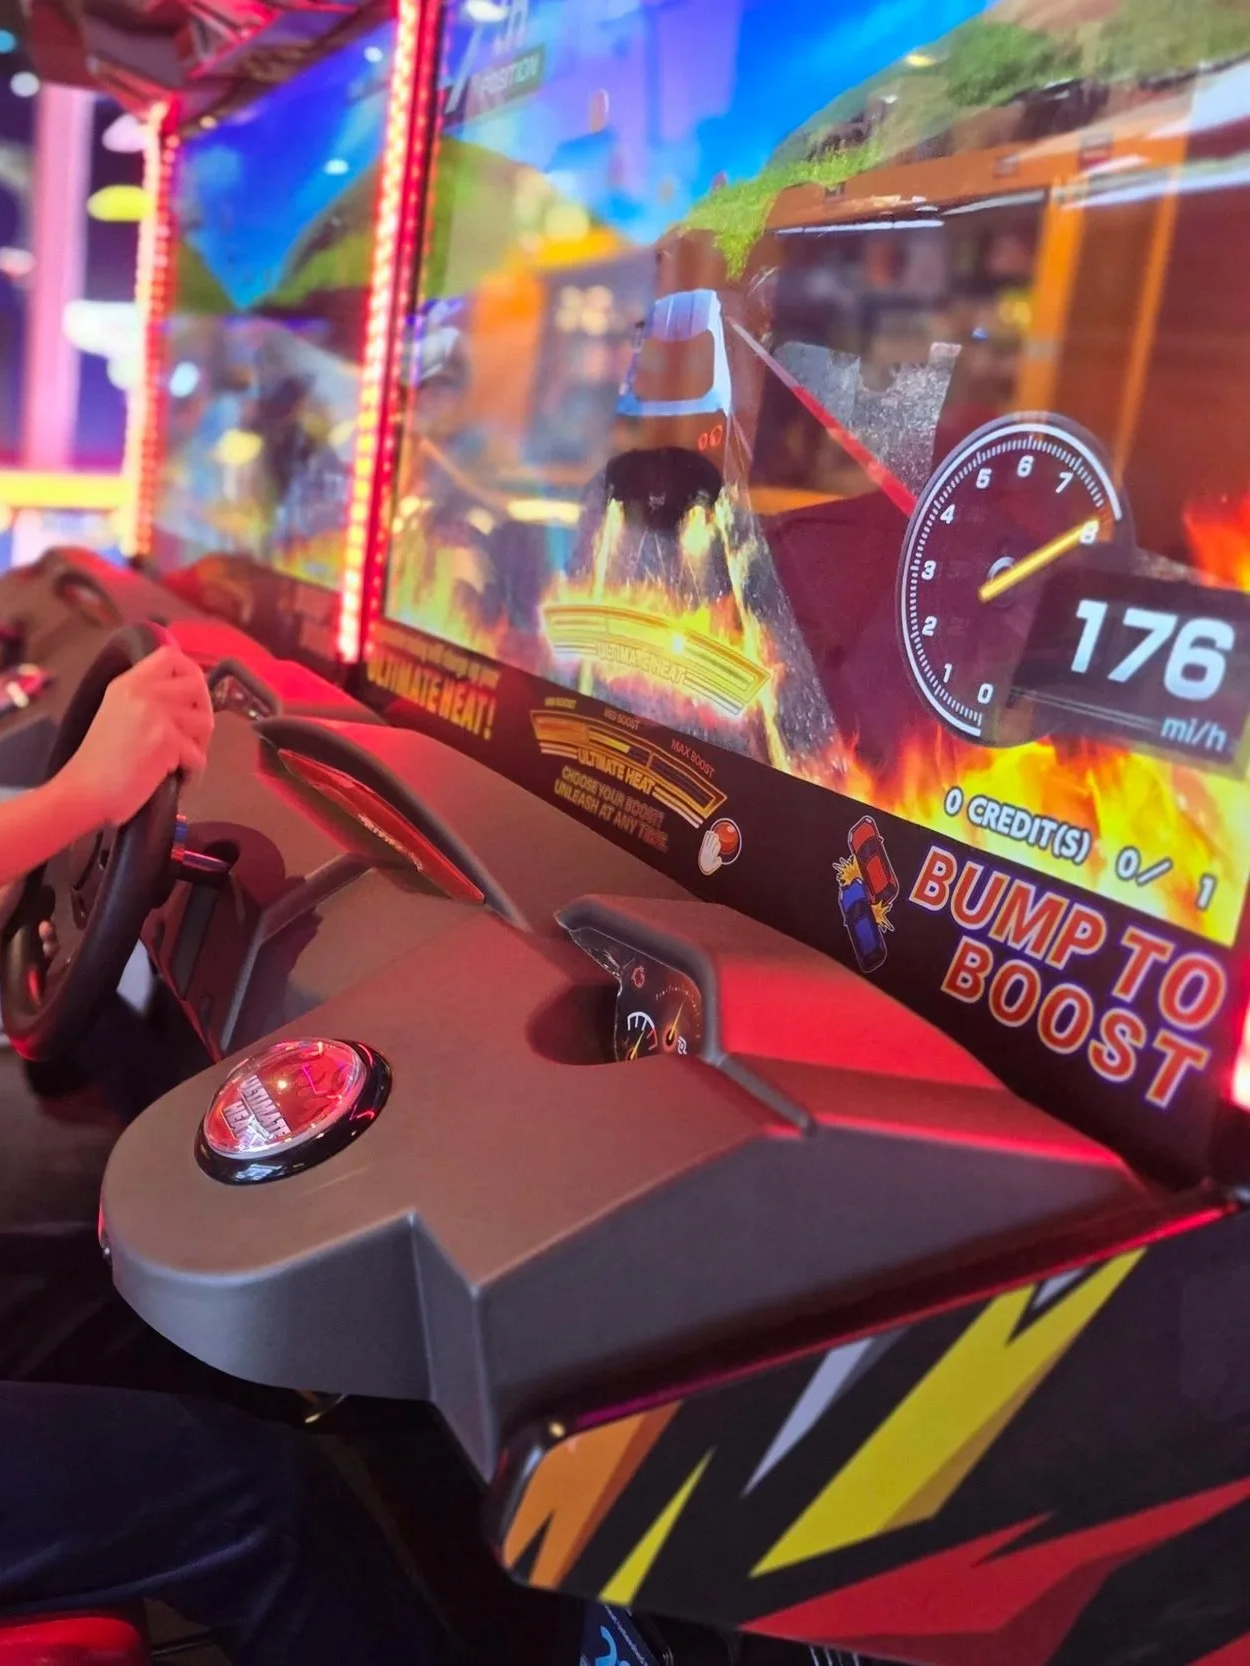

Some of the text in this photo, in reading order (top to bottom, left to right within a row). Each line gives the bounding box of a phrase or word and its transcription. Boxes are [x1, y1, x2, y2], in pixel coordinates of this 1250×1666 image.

[976, 467, 992, 489] 5
[1017, 455, 1034, 477] 6
[1055, 471, 1073, 493] 7
[940, 504, 955, 524] 4
[1079, 519, 1099, 544] 8
[921, 560, 937, 580] 3
[922, 616, 937, 636] 2
[598, 643, 686, 686] ULTIMATE HEAT
[1070, 598, 1236, 701] 176
[943, 663, 953, 683] 1
[438, 676, 496, 740] HEAT!
[977, 683, 993, 704] 0
[616, 711, 641, 731] BOOST
[1161, 716, 1227, 752] mi/h
[577, 747, 657, 796] ULTIMATE HEAT
[670, 738, 716, 778] MAX BOOST
[562, 765, 598, 792] CHOOSE
[598, 781, 625, 806] YOUR
[554, 778, 599, 817] UNLEASH
[598, 801, 616, 822] AT
[614, 807, 640, 836] ANY
[944, 787, 963, 816] 0
[967, 795, 1092, 864] CREDIT(S)
[1196, 873, 1217, 911] 1
[909, 845, 1226, 1030] BUMP TO
[940, 935, 1210, 1109] BOOST
[222, 1100, 260, 1146] HEA
[239, 1074, 292, 1143] ULTIMATE
